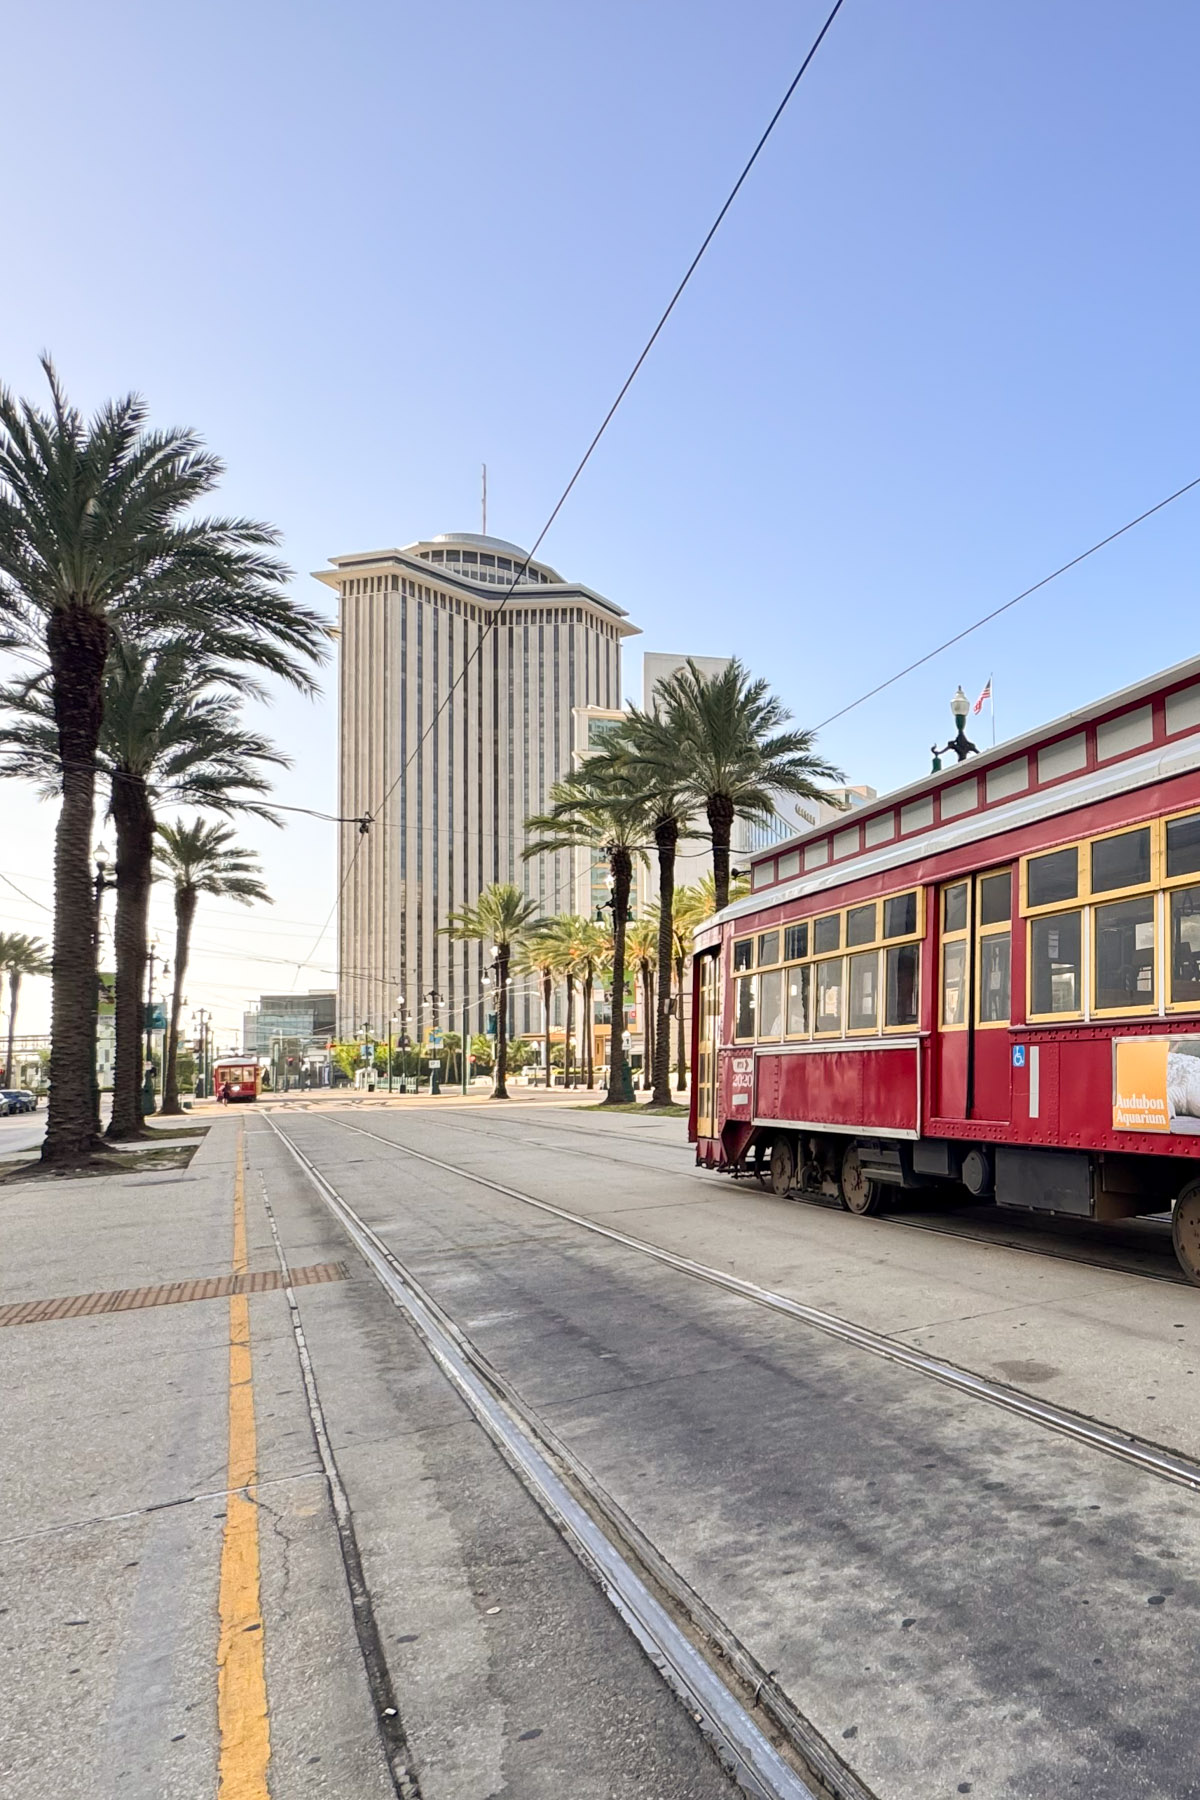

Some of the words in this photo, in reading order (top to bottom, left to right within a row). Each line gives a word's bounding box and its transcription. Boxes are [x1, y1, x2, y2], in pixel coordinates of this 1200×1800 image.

[732, 1073, 753, 1087] 2020
[1115, 1093, 1165, 1110] Audubon
[1116, 1109, 1167, 1127] Aquarium
